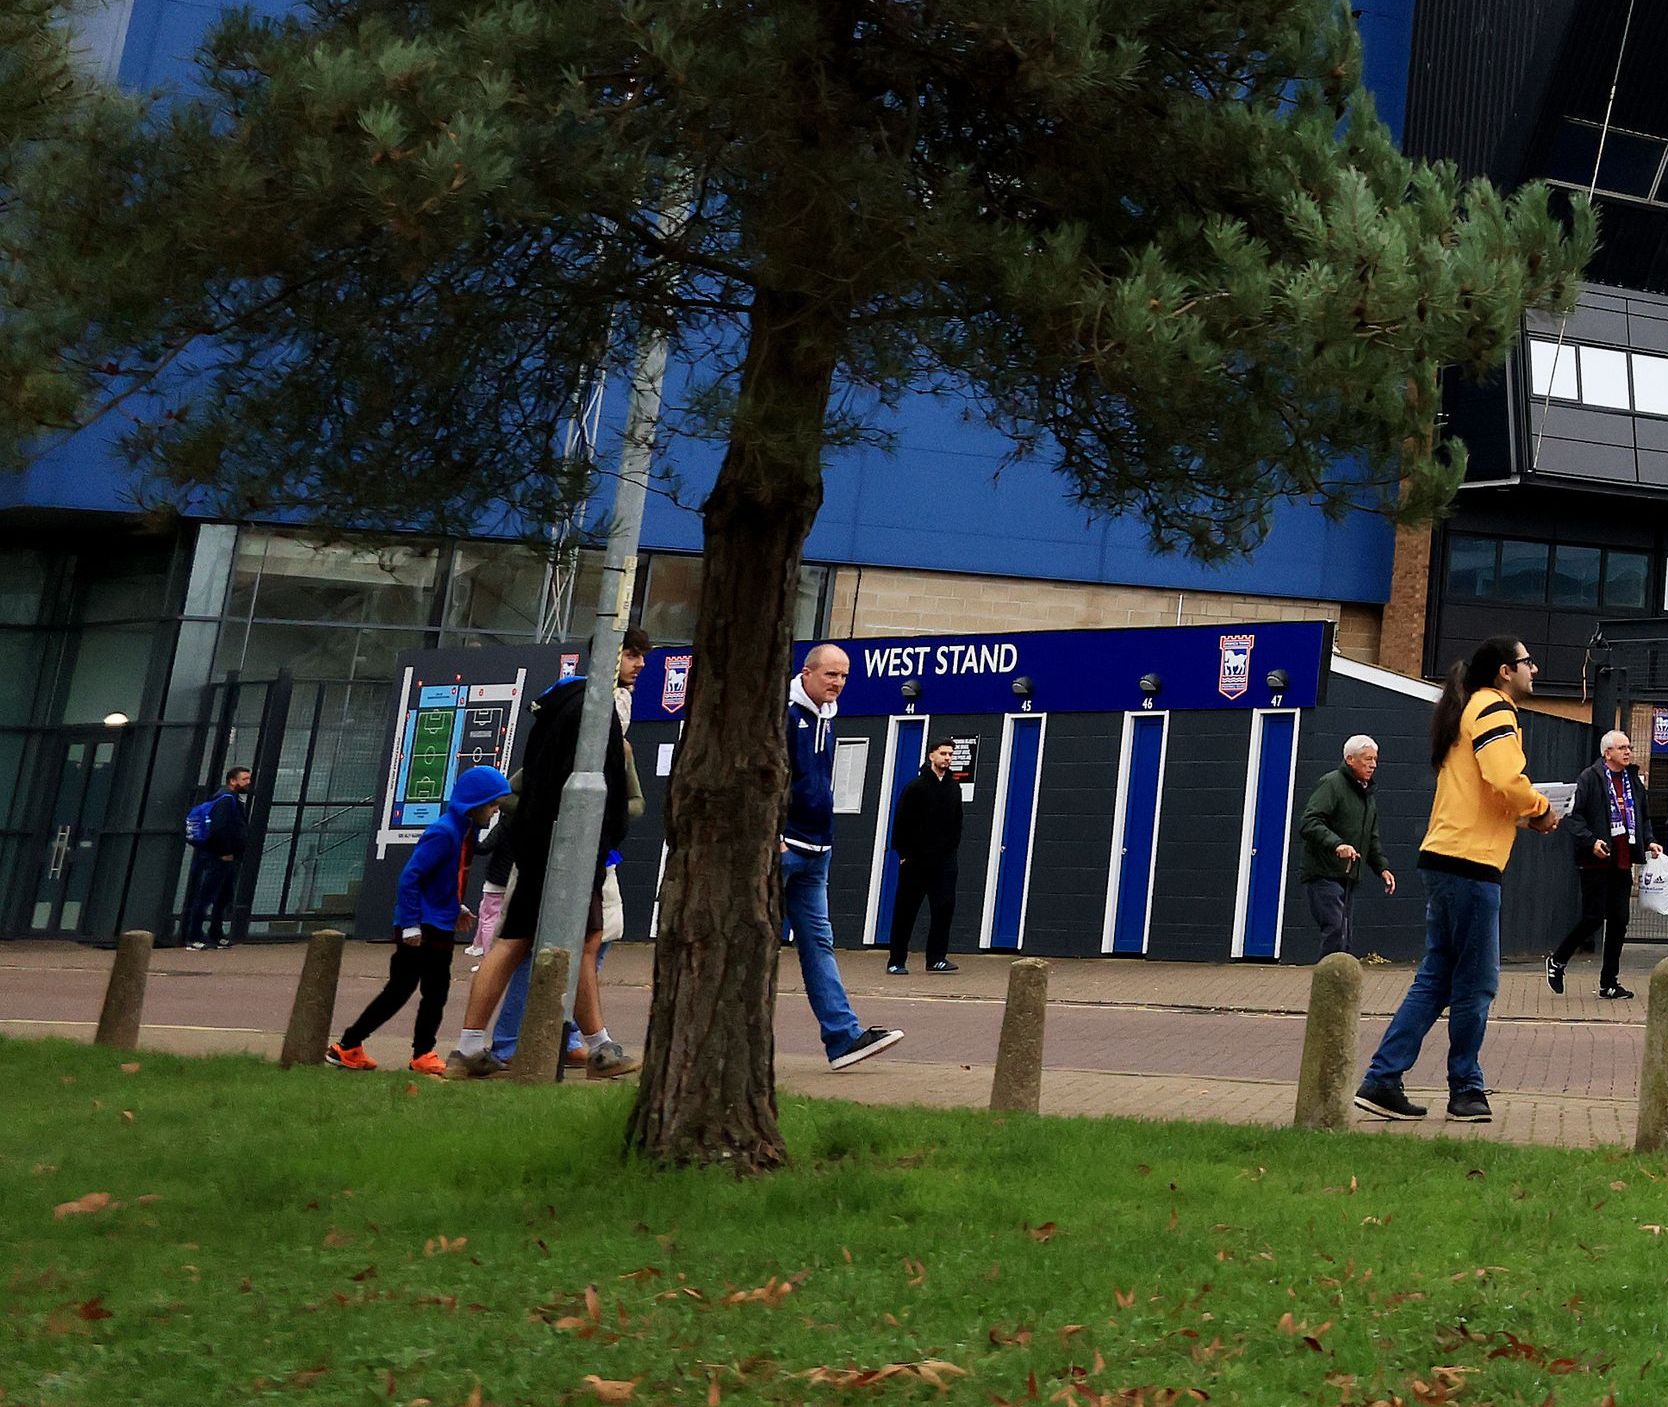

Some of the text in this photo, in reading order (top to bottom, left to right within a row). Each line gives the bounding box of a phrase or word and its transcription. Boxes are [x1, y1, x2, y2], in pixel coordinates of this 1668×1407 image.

[864, 643, 1018, 678] WEST STAND
[1021, 700, 1032, 712] 45
[1142, 697, 1153, 710] 46
[1270, 694, 1283, 707] 47
[905, 703, 915, 714] 44
